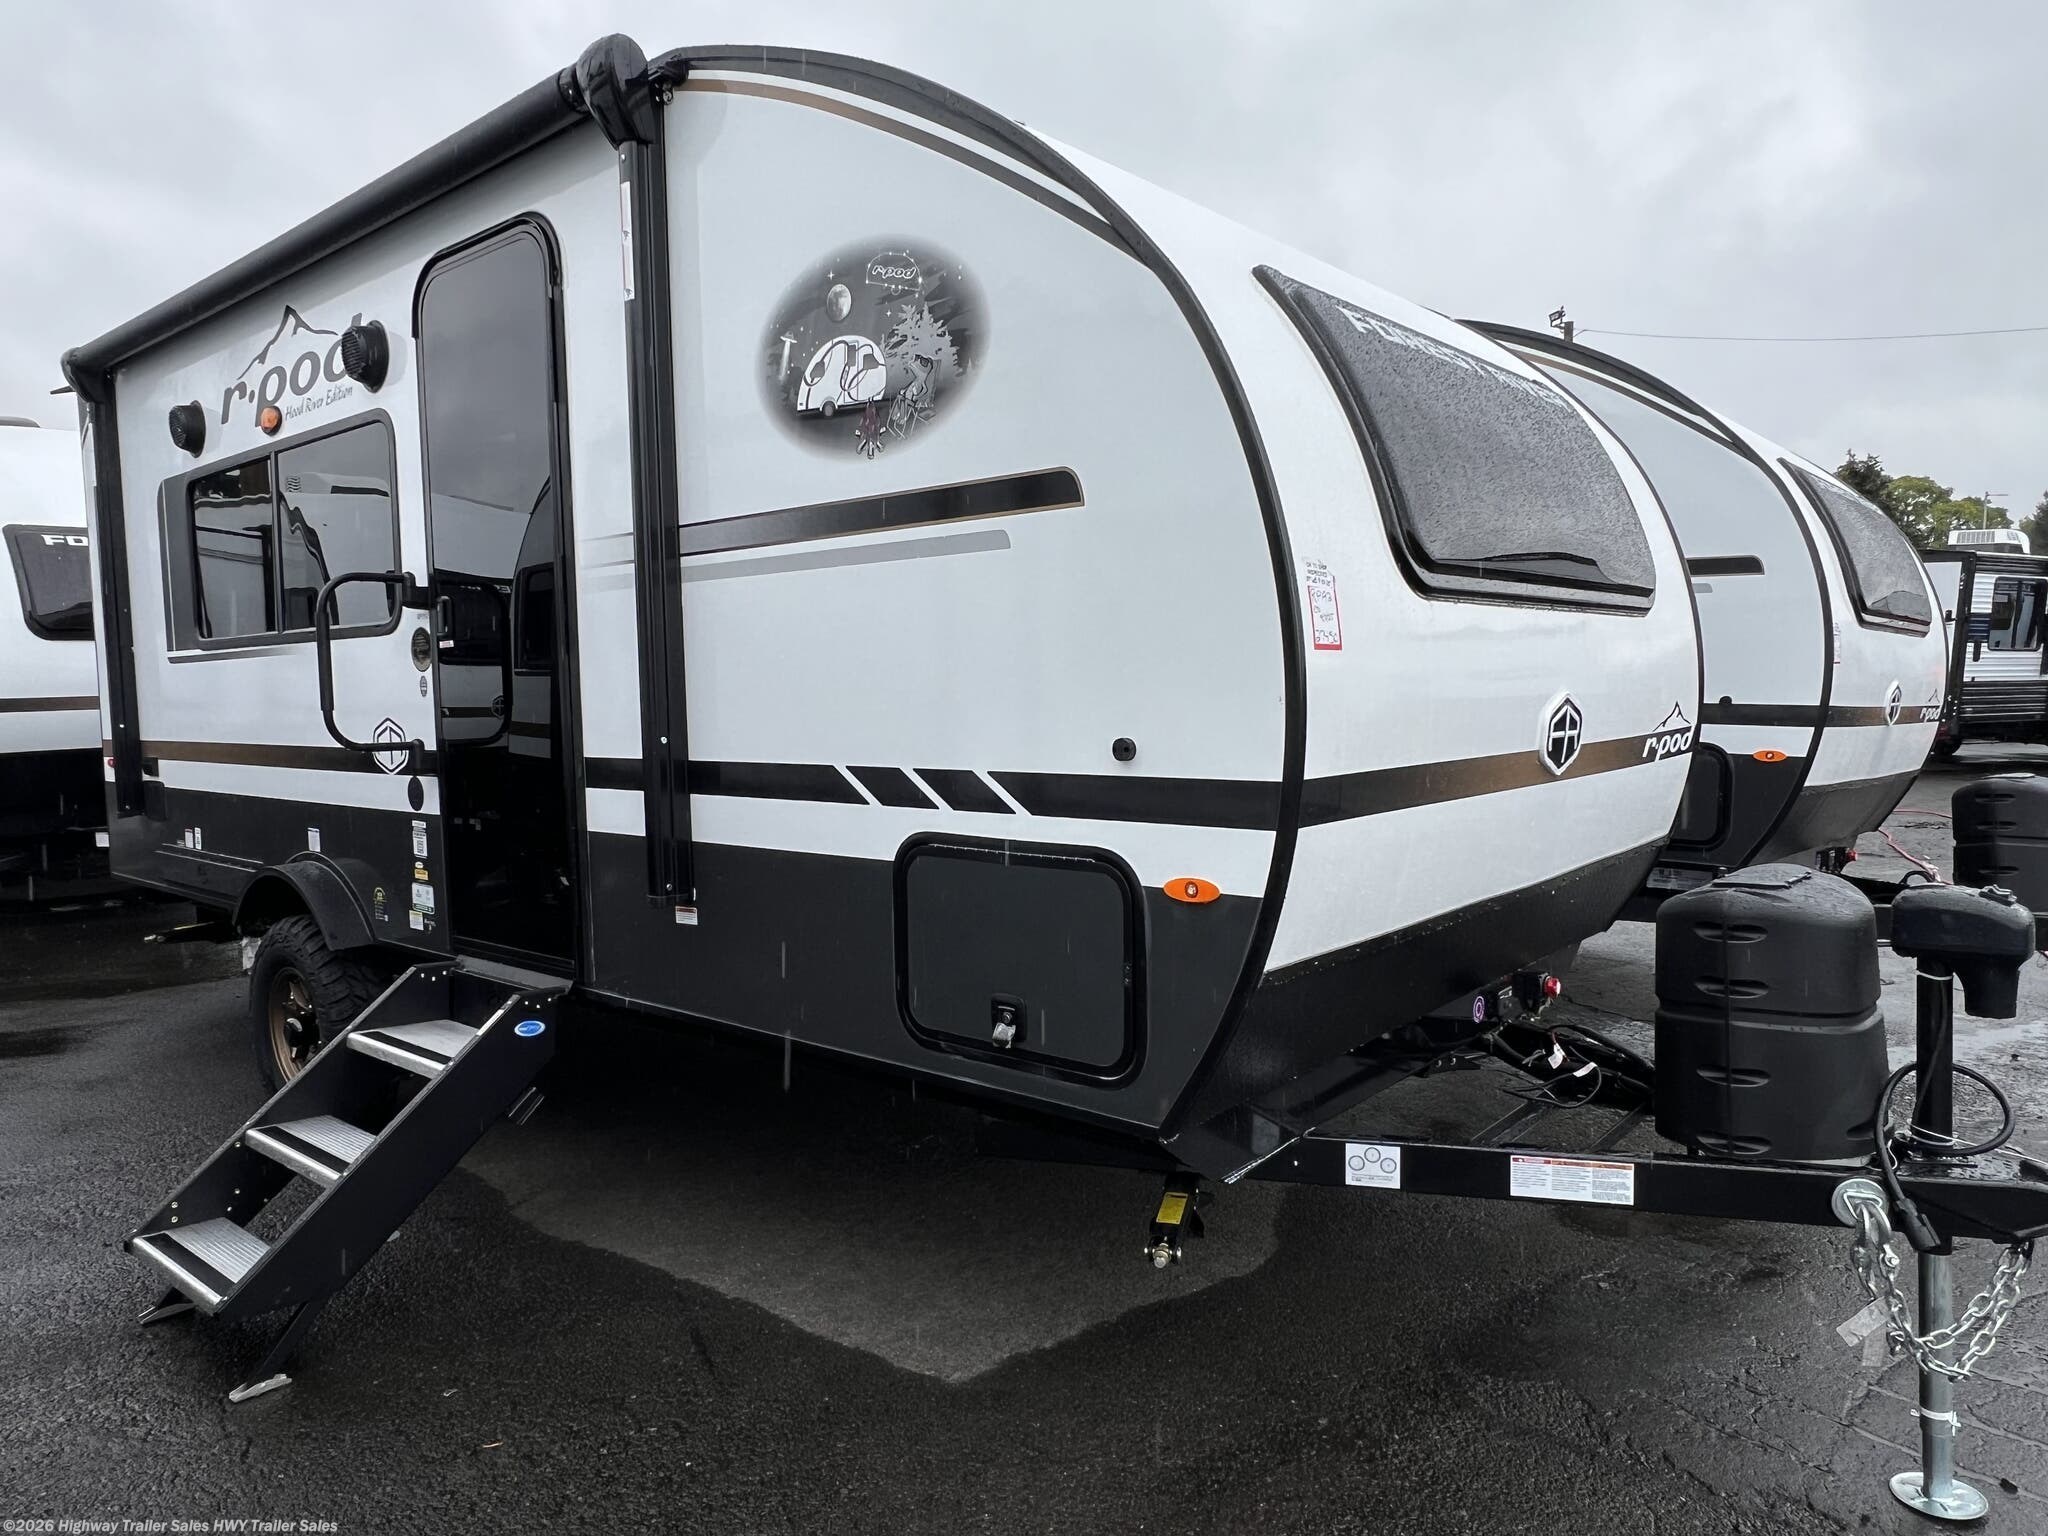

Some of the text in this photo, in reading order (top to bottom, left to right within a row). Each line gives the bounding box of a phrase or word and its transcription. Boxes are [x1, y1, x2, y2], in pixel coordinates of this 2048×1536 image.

[284, 384, 354, 421] Hood River Edition
